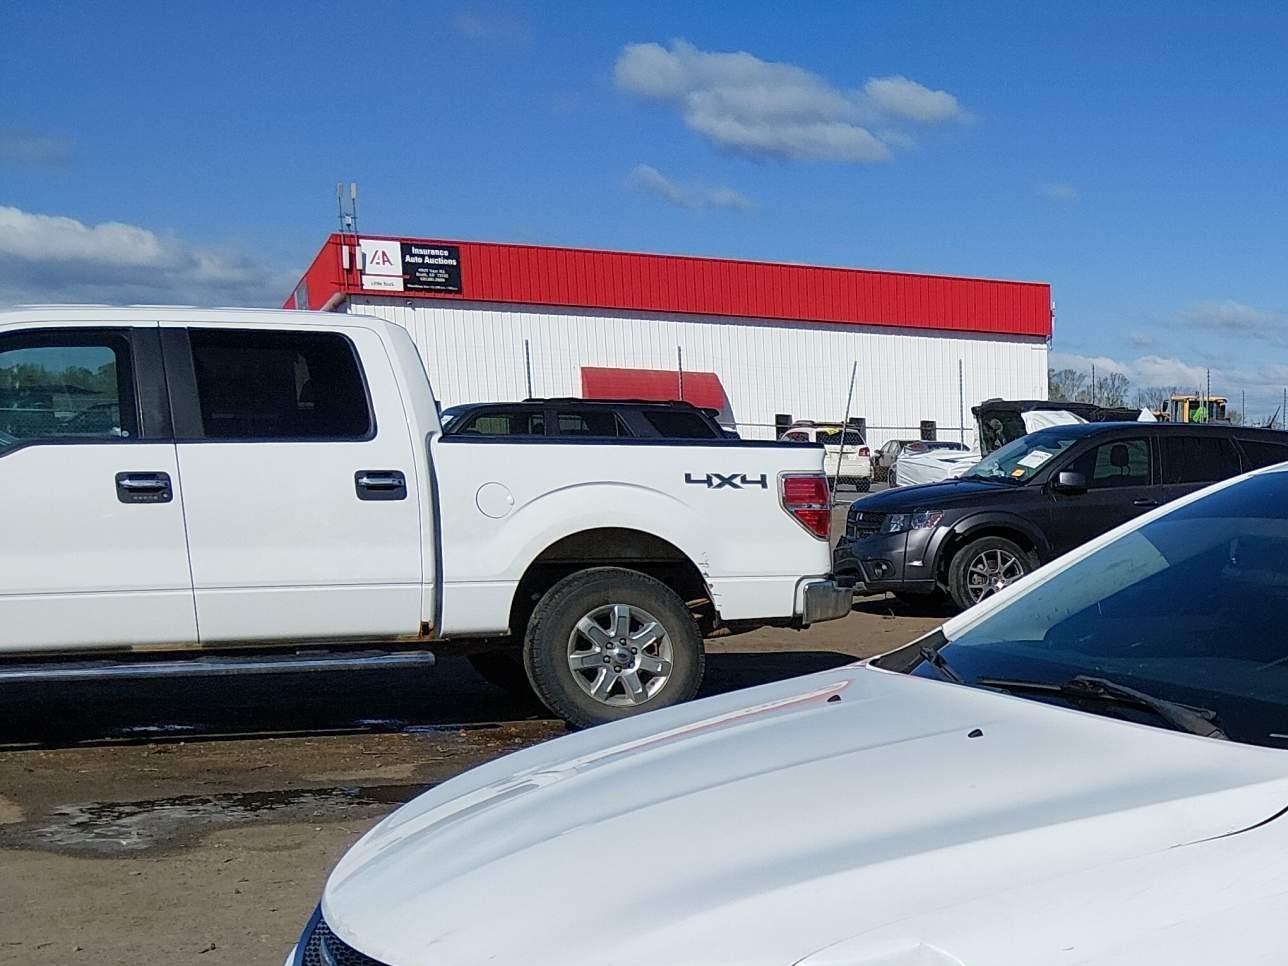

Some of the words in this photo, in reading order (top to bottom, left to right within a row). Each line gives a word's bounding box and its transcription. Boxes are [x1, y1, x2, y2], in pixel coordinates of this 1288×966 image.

[411, 246, 449, 257] Insurance
[405, 255, 423, 264] Auto
[424, 256, 457, 266] Auctions
